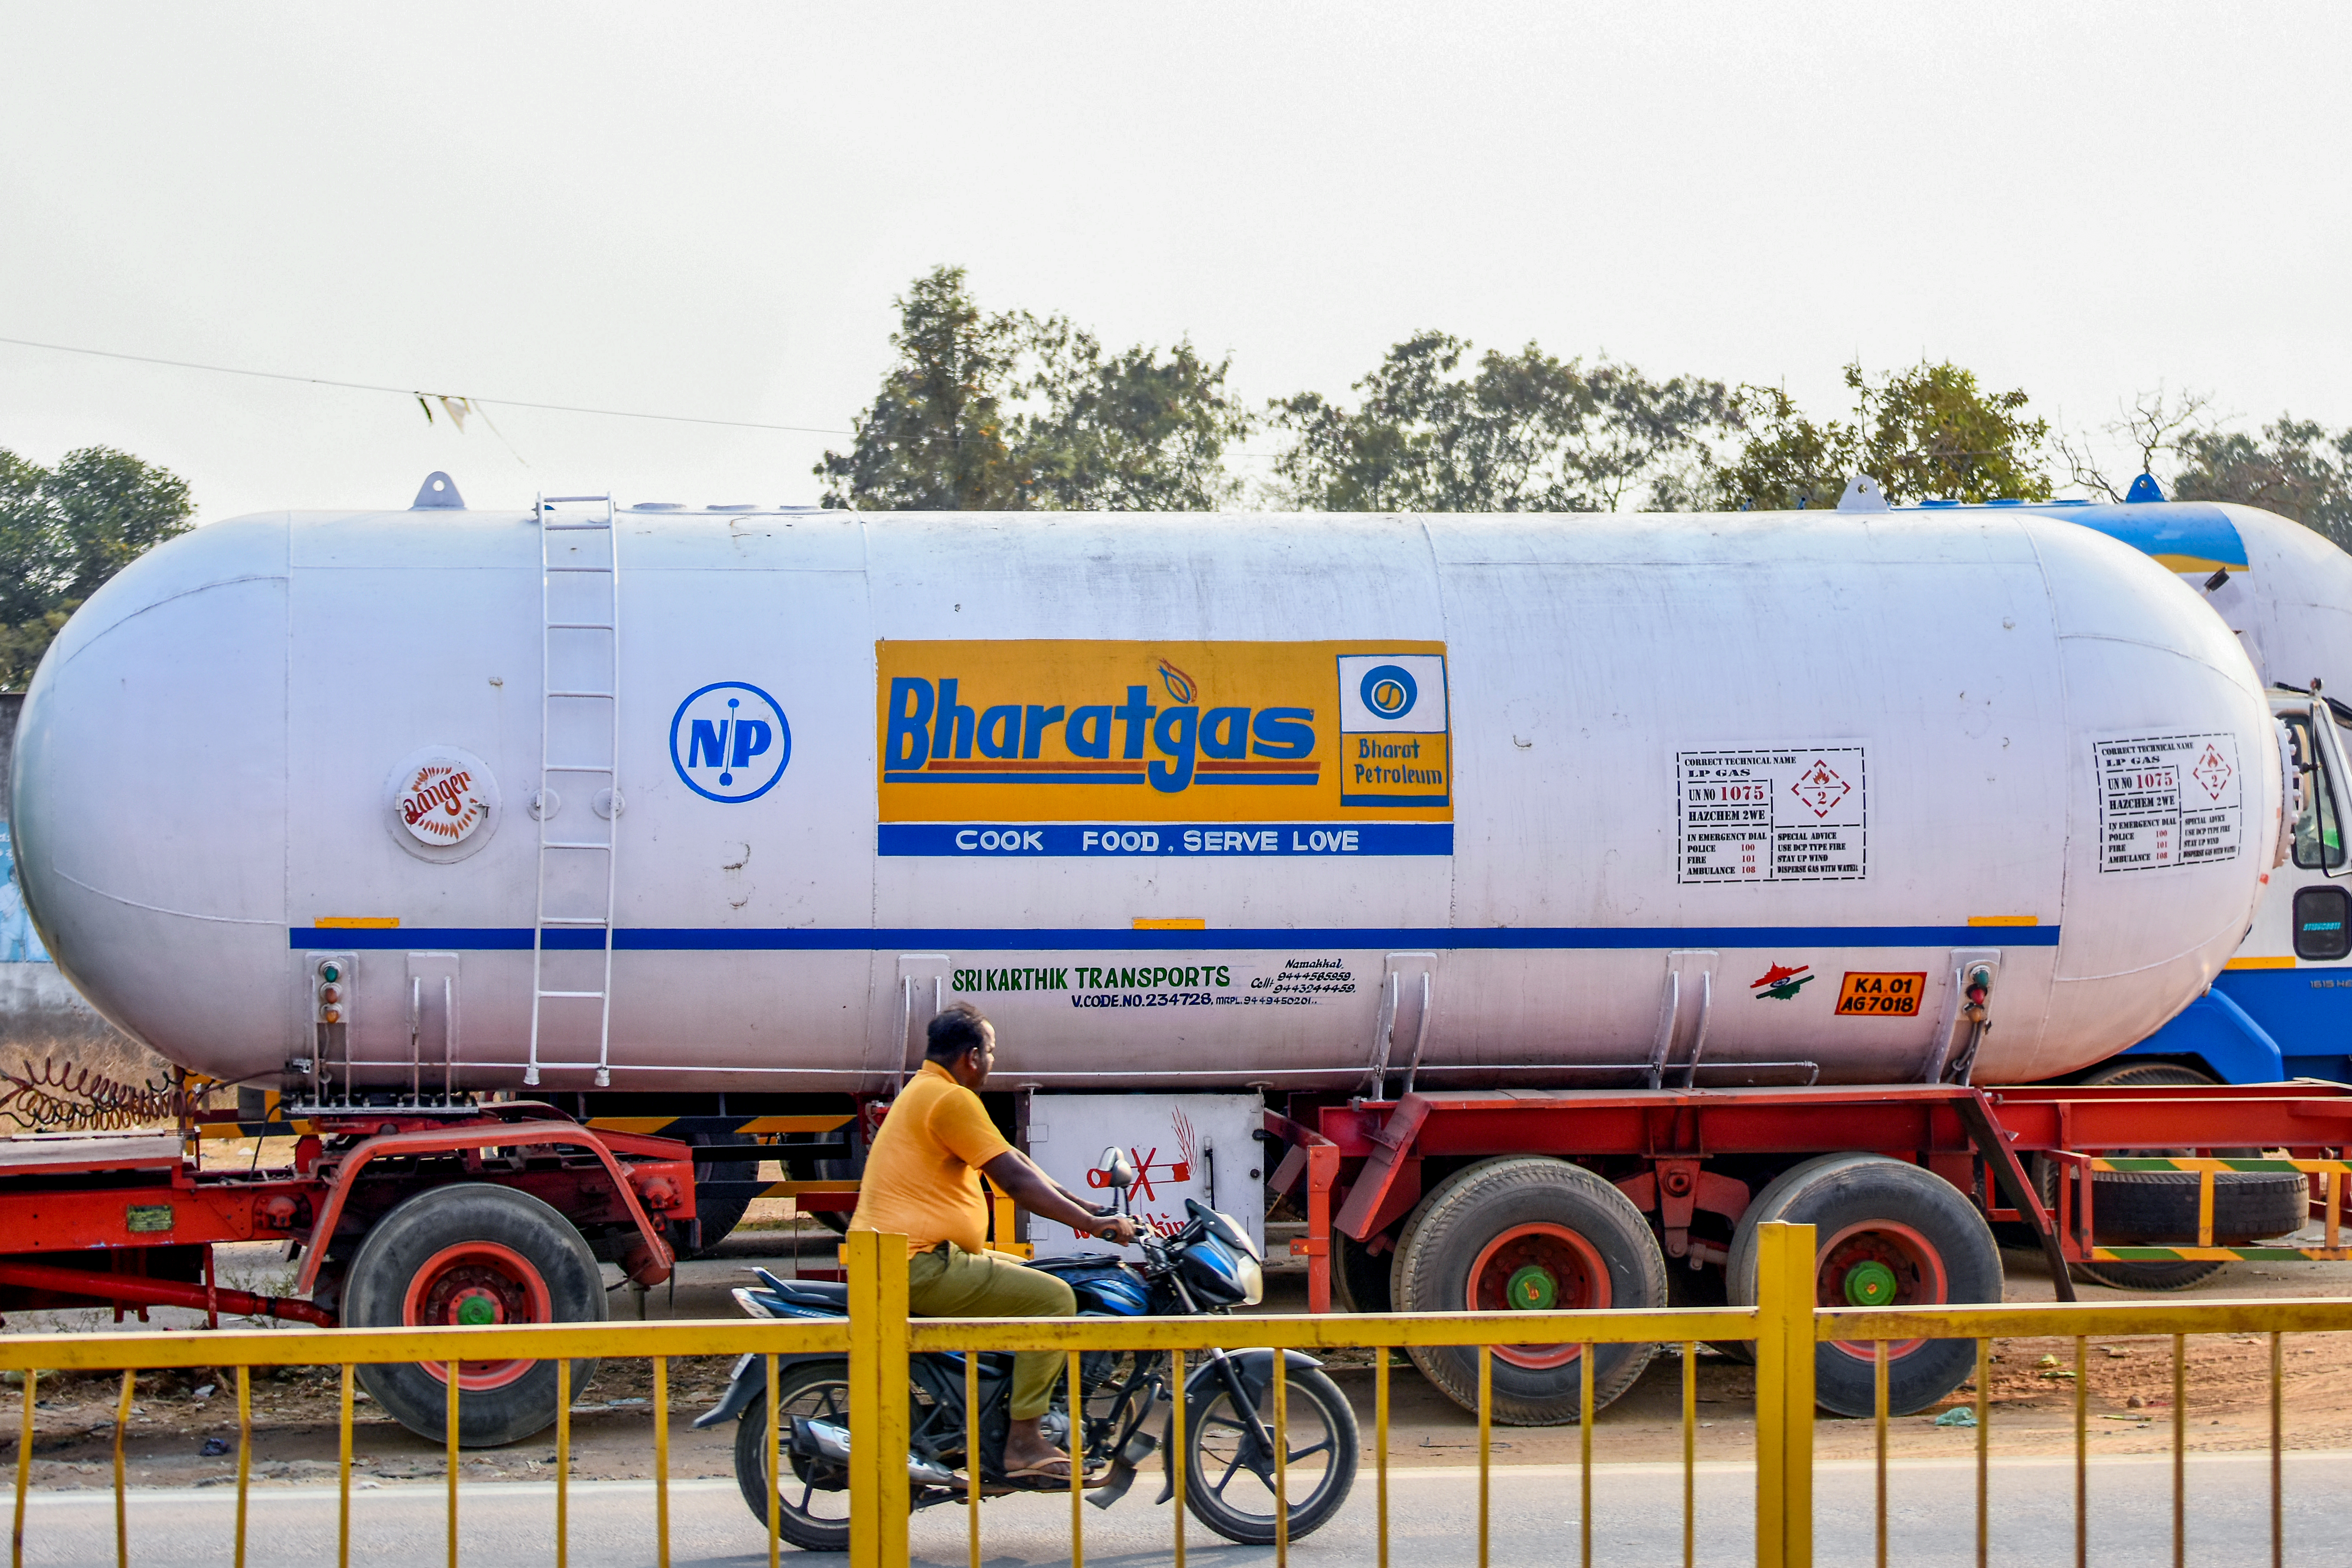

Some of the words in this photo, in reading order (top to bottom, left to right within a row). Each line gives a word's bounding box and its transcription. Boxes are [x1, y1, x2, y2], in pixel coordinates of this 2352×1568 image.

[884, 676, 1316, 793] Bharatgas
[688, 719, 772, 769] NP
[1358, 739, 1419, 758] Bharat
[2101, 746, 2136, 756] CORRECT
[2138, 743, 2175, 753] TECHNICAL
[2177, 742, 2193, 750] NAME
[1724, 757, 1771, 765] TECHNICAL
[2107, 758, 2126, 766] LP
[2131, 756, 2160, 764] GAS
[1355, 764, 1442, 784] Petroleum
[2108, 777, 2119, 790] UN
[2122, 777, 2132, 788] NO
[2137, 772, 2172, 789] 1075
[2212, 775, 2218, 787] 2
[1689, 789, 1701, 801] UN
[1703, 789, 1716, 800] NO
[1721, 786, 1764, 801] 1075
[1818, 791, 1827, 804] 2
[2109, 797, 2154, 810] HAZCHEM
[2157, 795, 2175, 806] 2WE
[1689, 811, 1740, 821] HAZCHEM
[1743, 810, 1765, 820] 2WE
[2185, 817, 2206, 826] SPECIAL
[2109, 822, 2117, 831] IN
[2119, 819, 2159, 830] EMERGENCY
[2162, 818, 2176, 826] DIAL
[1699, 833, 1746, 841] EMERGENCY
[1748, 832, 1767, 841] DIAL
[1811, 832, 1837, 840] ADVICE
[2109, 832, 2134, 841] POLICE
[2156, 830, 2167, 838] 100
[2185, 828, 2194, 837] USE
[955, 831, 1043, 851] COOK
[1183, 831, 1278, 851] SERVE
[1292, 831, 1359, 851] LOVE
[2109, 844, 2125, 853] FIRE
[2156, 841, 2167, 849] 101
[2184, 839, 2198, 848] STAY
[1687, 845, 1716, 853] POLICE
[1687, 856, 1706, 864] FIRE
[2108, 853, 2150, 864] AMBULANCE
[2156, 852, 2167, 860] 108
[1687, 867, 1735, 875] AMBULANCE
[952, 969, 982, 992] SRI
[986, 968, 1068, 991] KARTHIK
[1075, 965, 1231, 989] TRANSPORTS
